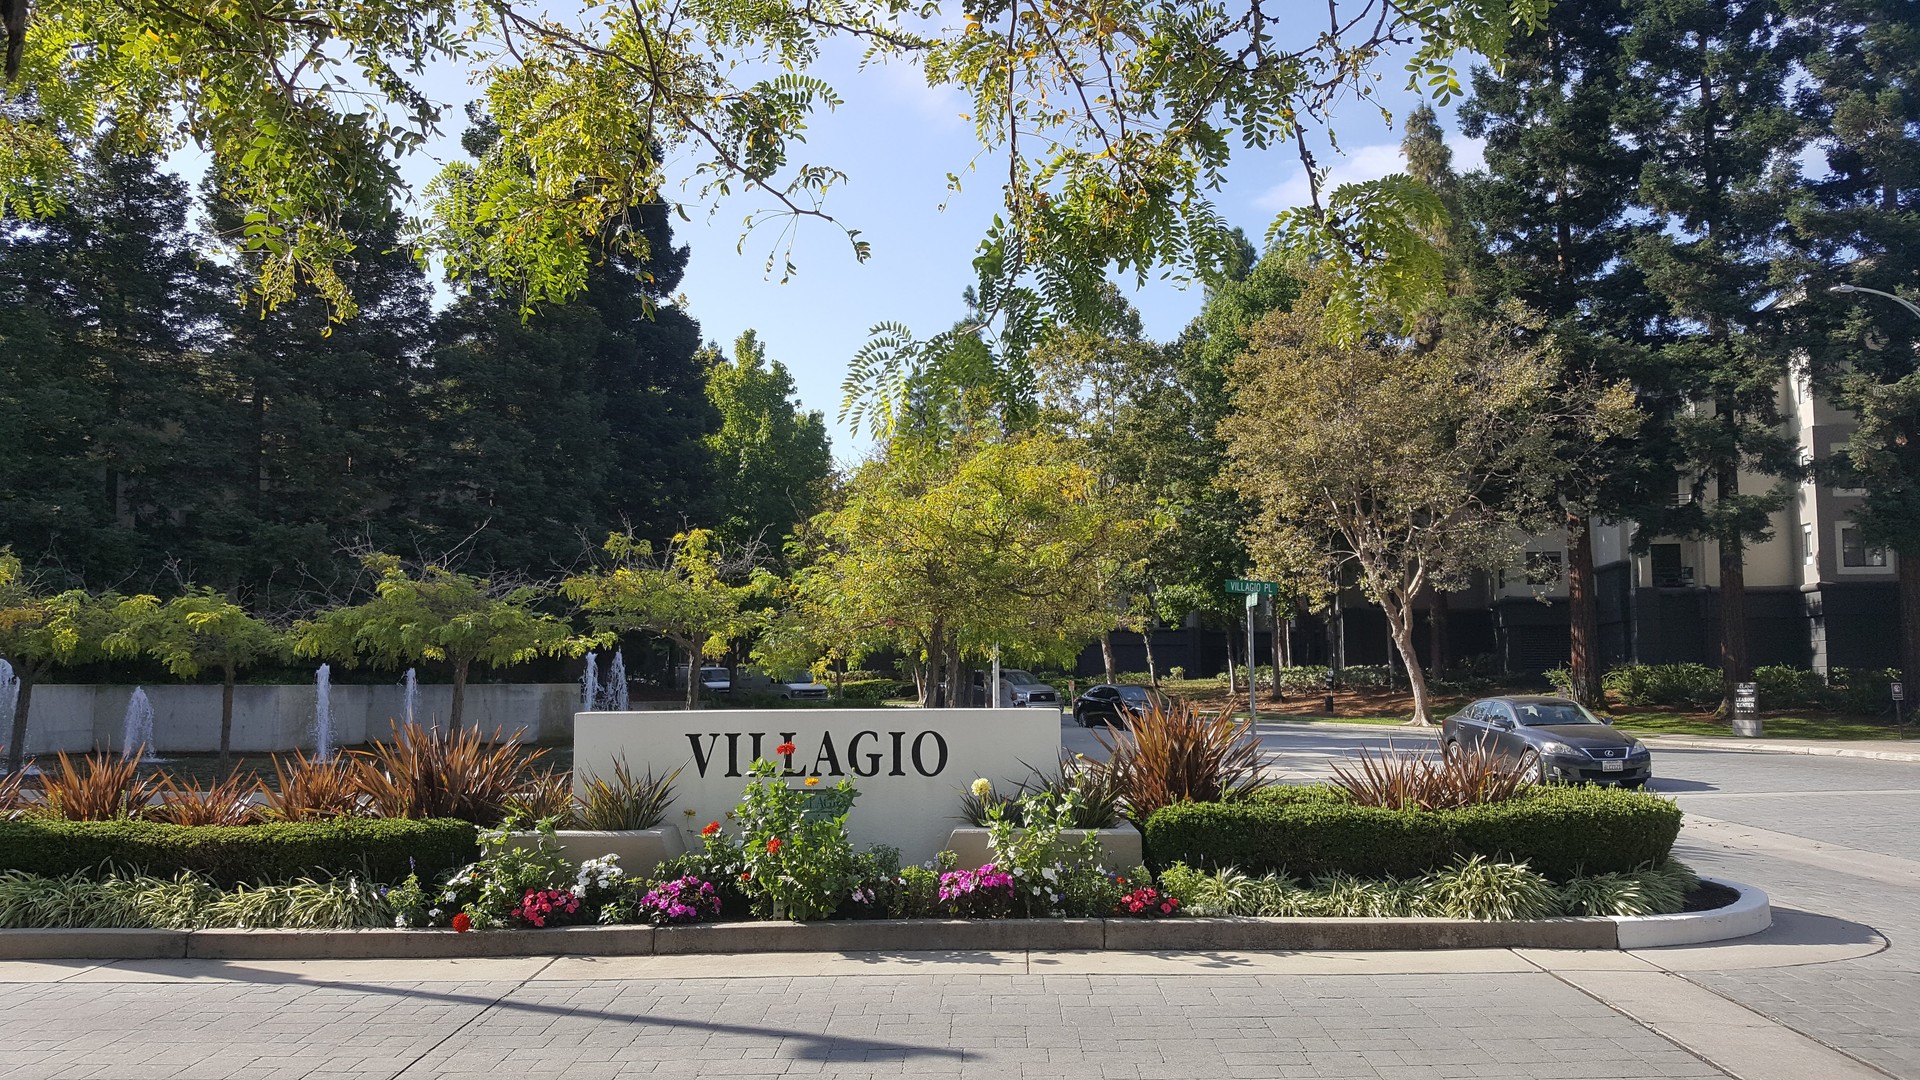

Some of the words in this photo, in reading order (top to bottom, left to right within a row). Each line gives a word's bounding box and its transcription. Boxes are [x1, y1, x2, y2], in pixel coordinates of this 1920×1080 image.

[1230, 581, 1261, 592] VILLAGIO
[1264, 583, 1273, 593] PL
[685, 730, 949, 779] VILLAGIO
